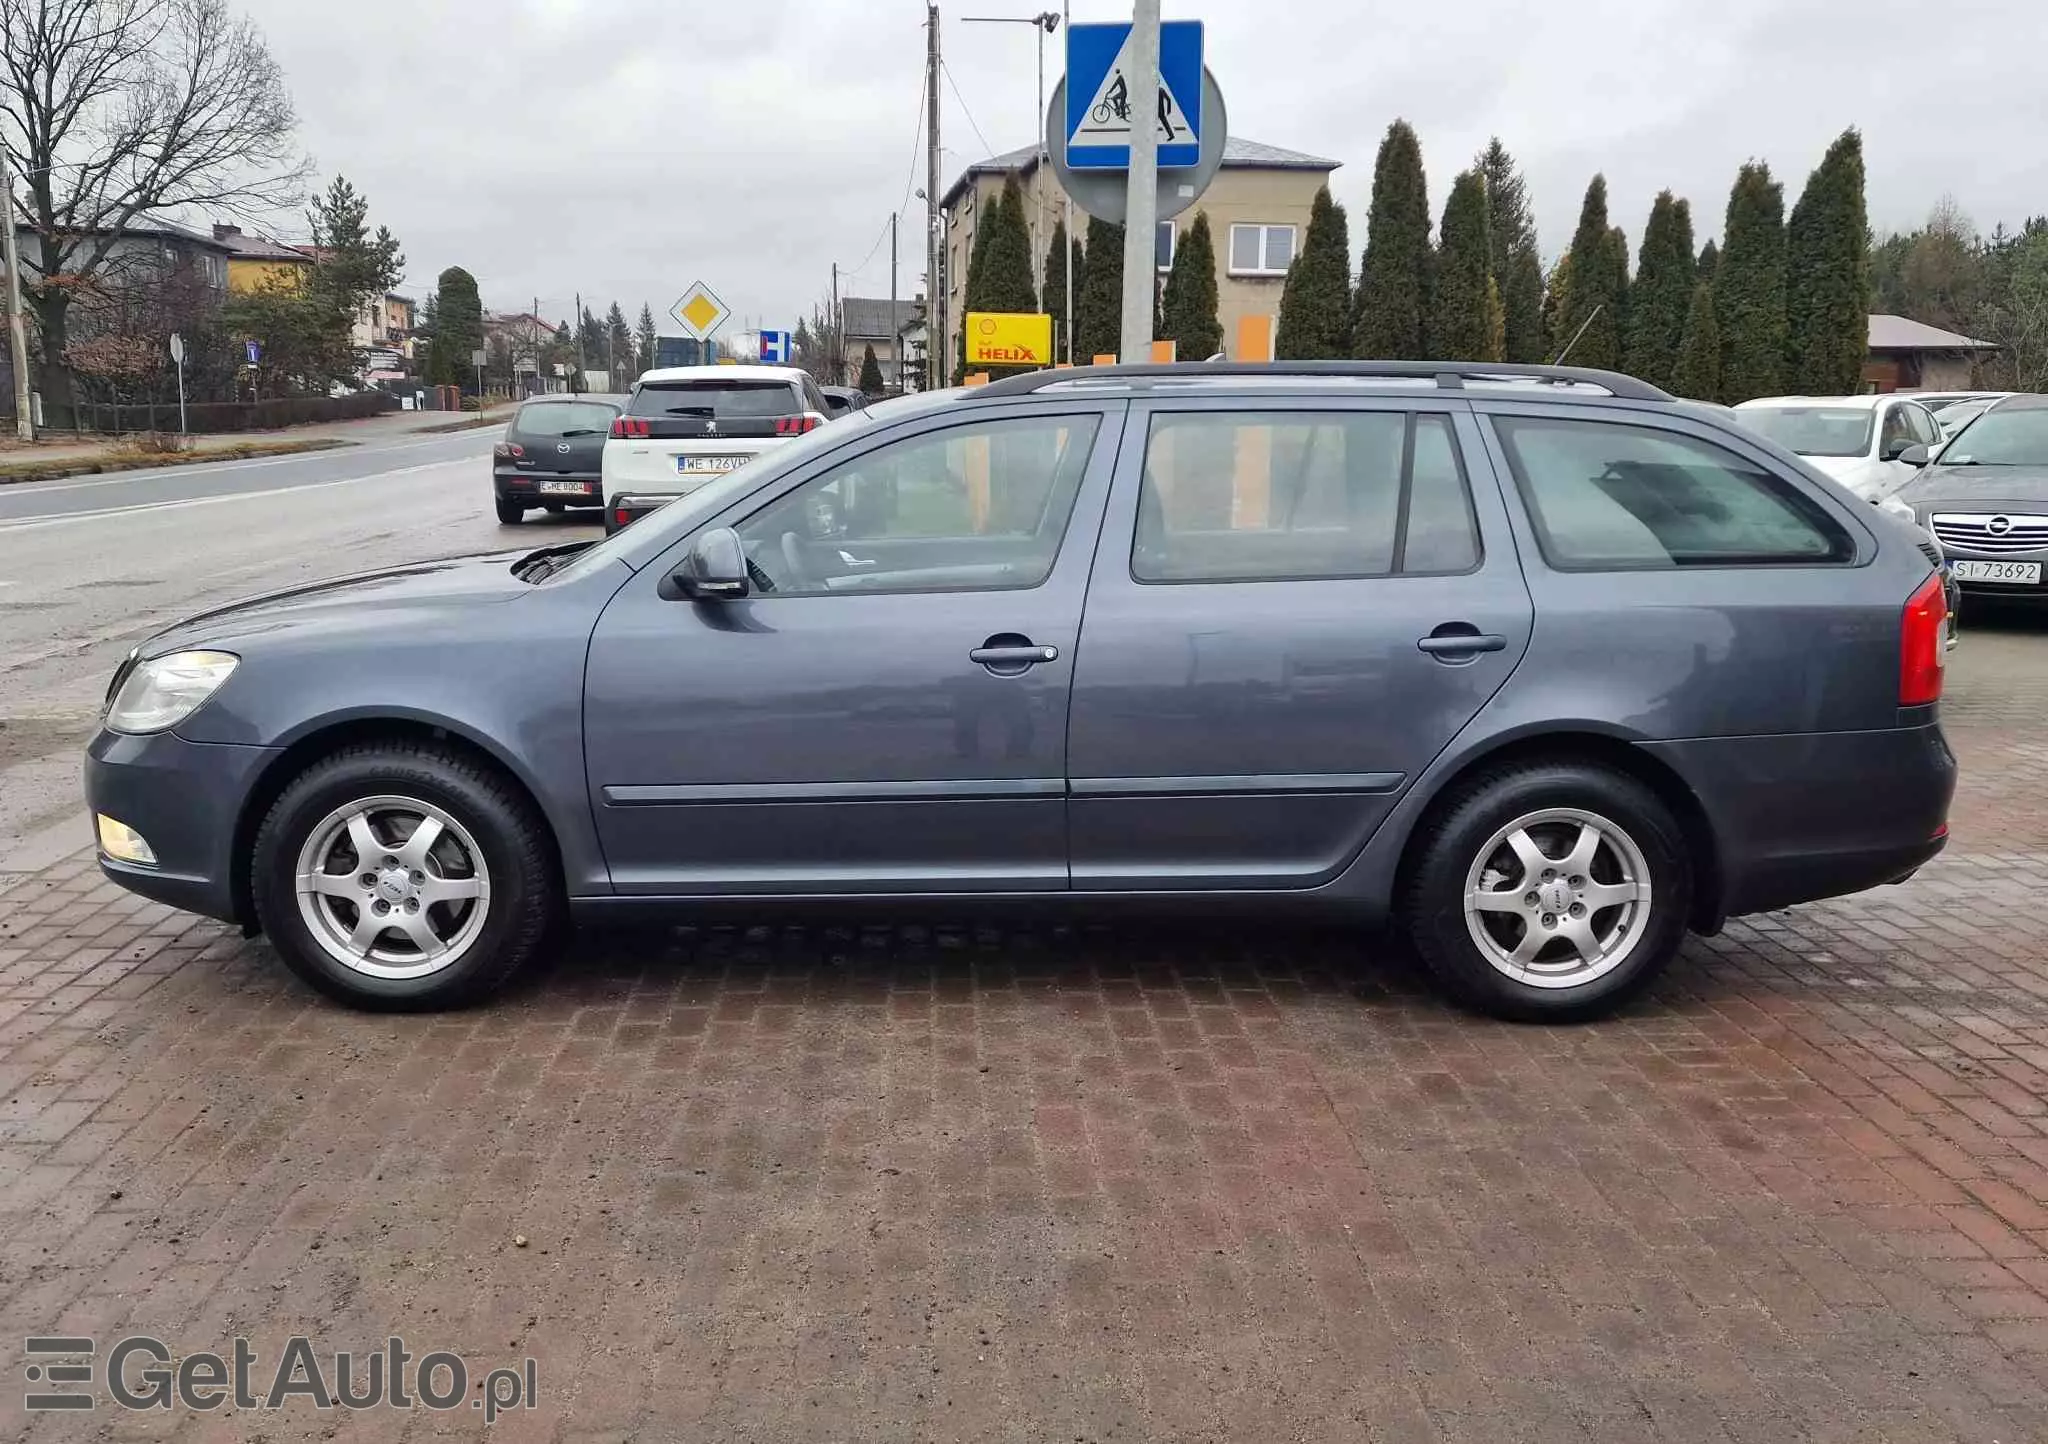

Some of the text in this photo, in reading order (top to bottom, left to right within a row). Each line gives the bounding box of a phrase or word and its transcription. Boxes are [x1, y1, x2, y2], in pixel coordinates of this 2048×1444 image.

[977, 346, 1037, 361] HELIX
[687, 457, 703, 470] WE
[1956, 562, 2037, 579] SI 73692
